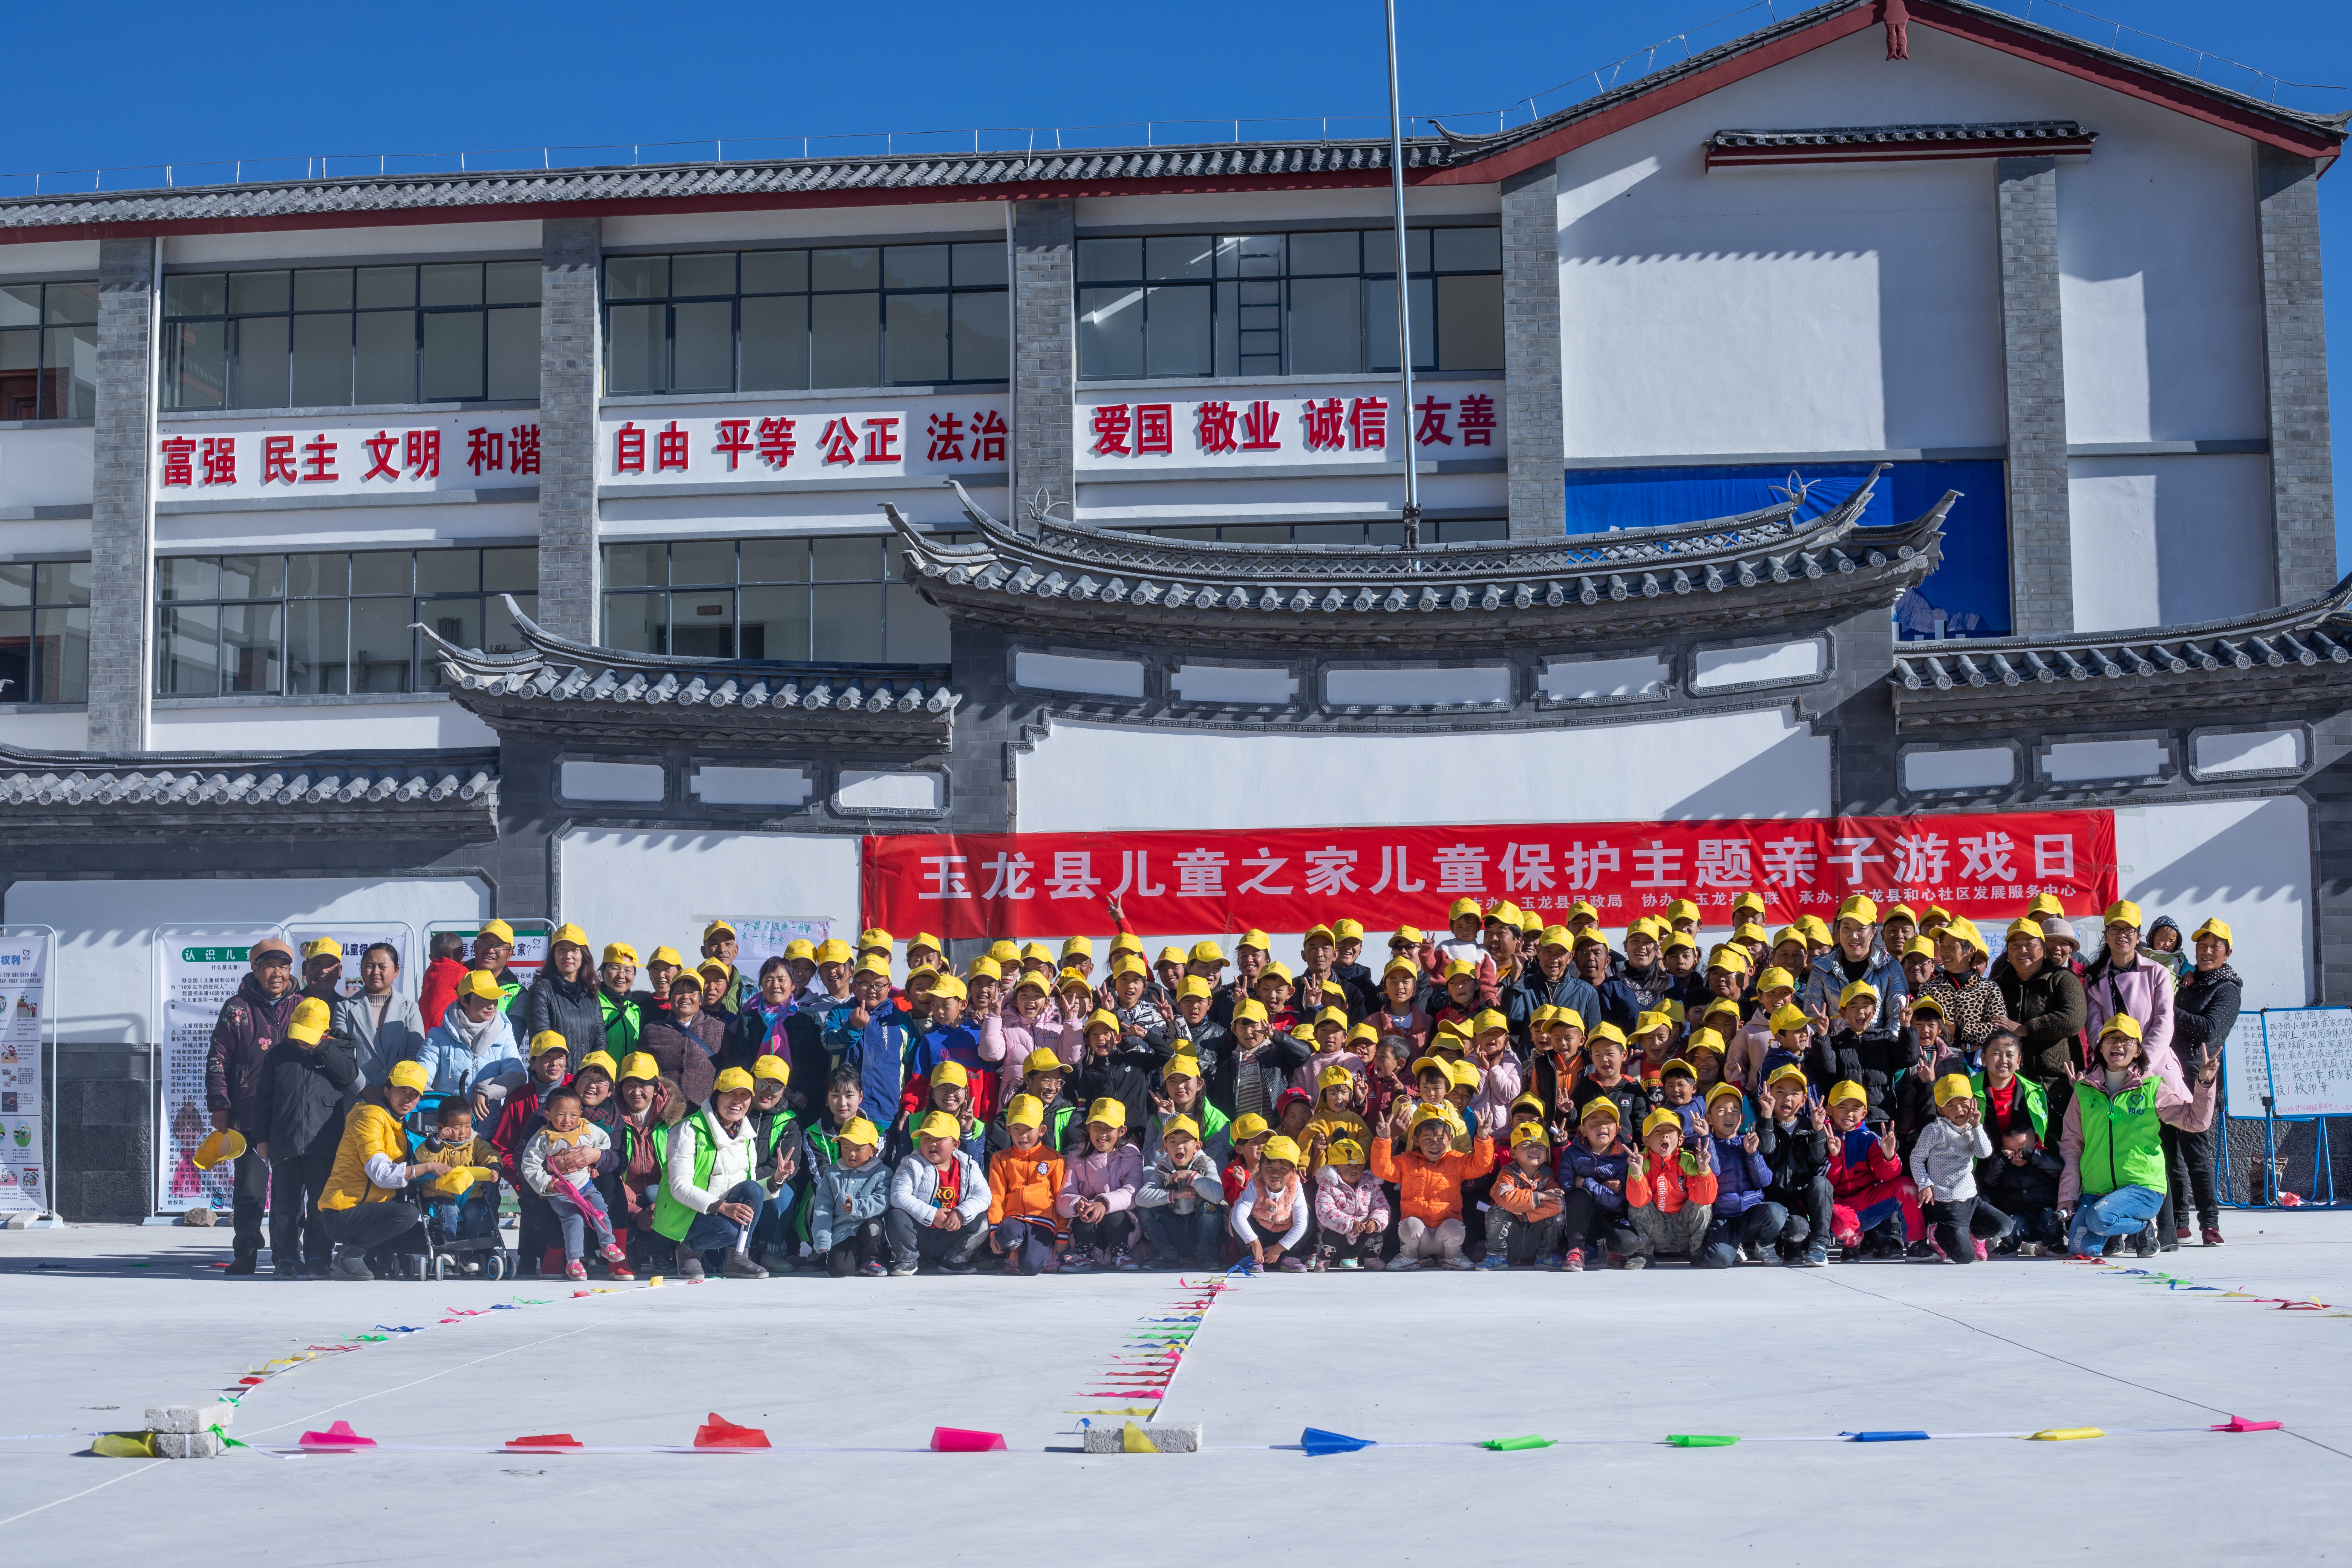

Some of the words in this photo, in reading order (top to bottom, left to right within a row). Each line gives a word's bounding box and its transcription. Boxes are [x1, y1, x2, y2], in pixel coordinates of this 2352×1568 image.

[1094, 404, 1173, 455] 爱国
[1199, 401, 1281, 452] 敬业
[1305, 396, 1387, 449] 诚信
[1415, 394, 1497, 447] 友善
[618, 421, 689, 472] 自由
[717, 417, 796, 469] 平等
[821, 416, 901, 465] 公正
[926, 410, 1008, 462] 法治
[162, 436, 237, 486] 富强
[264, 433, 339, 484] 民主
[365, 430, 440, 480] 文明
[467, 424, 540, 476] 和谐
[919, 831, 2076, 900] 玉龙县儿童之家儿童保护主题亲子游戏日
[1642, 893, 1674, 907] 协办
[341, 943, 372, 956] 儿童相
[1, 955, 20, 965] 权利
[2283, 1010, 2330, 1021] 爱的抱抱
[2269, 1018, 2352, 1031] 孩子的小脚踩在家长的
[1043, 1031, 1057, 1043] joku
[2127, 1107, 2145, 1115] 和心
